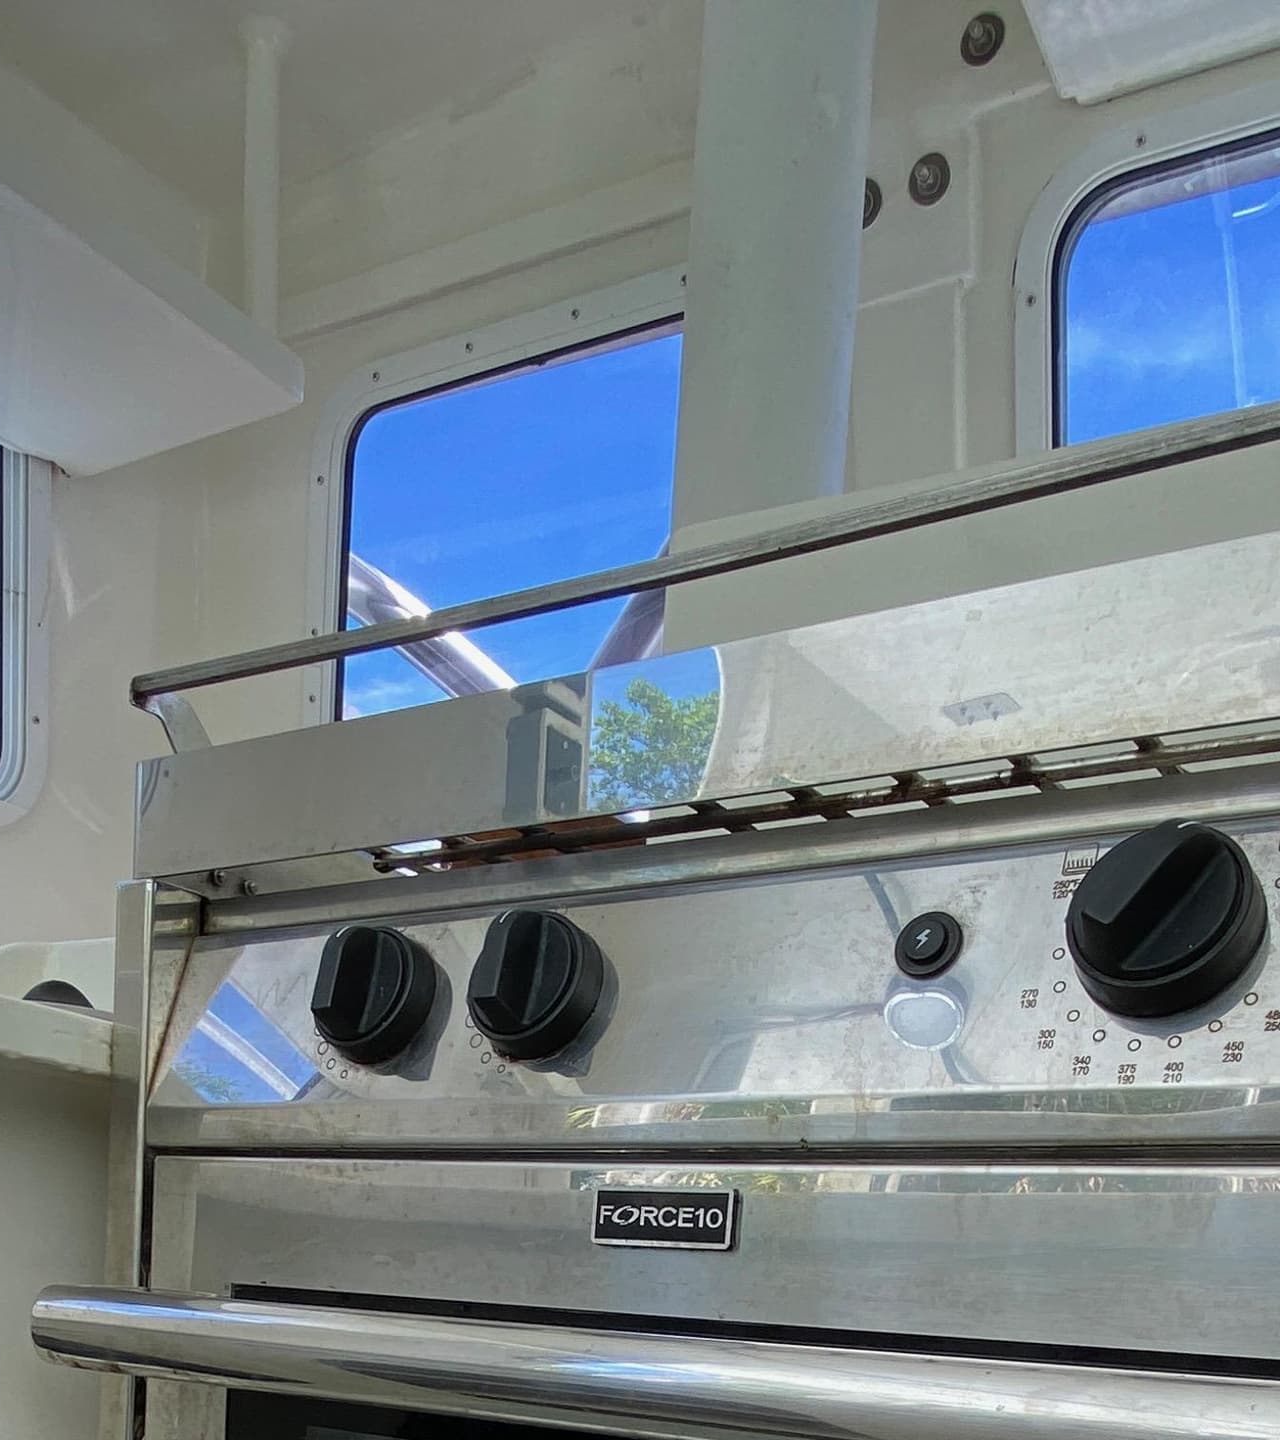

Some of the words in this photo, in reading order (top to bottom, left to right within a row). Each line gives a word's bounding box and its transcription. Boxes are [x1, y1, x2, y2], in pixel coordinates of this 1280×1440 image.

[1020, 988, 1039, 999] 270
[1020, 998, 1037, 1009] 130
[1037, 1029, 1057, 1040] 300
[1036, 1039, 1054, 1050] 150
[1223, 1041, 1245, 1052] 450
[1072, 1055, 1092, 1066] 340
[1222, 1052, 1243, 1063] 230
[1072, 1065, 1090, 1076] 170
[1117, 1063, 1137, 1074] 375
[1163, 1061, 1184, 1072] 400
[1116, 1074, 1136, 1085] 190
[1162, 1072, 1183, 1083] 210
[598, 1204, 724, 1229] FORCE10
